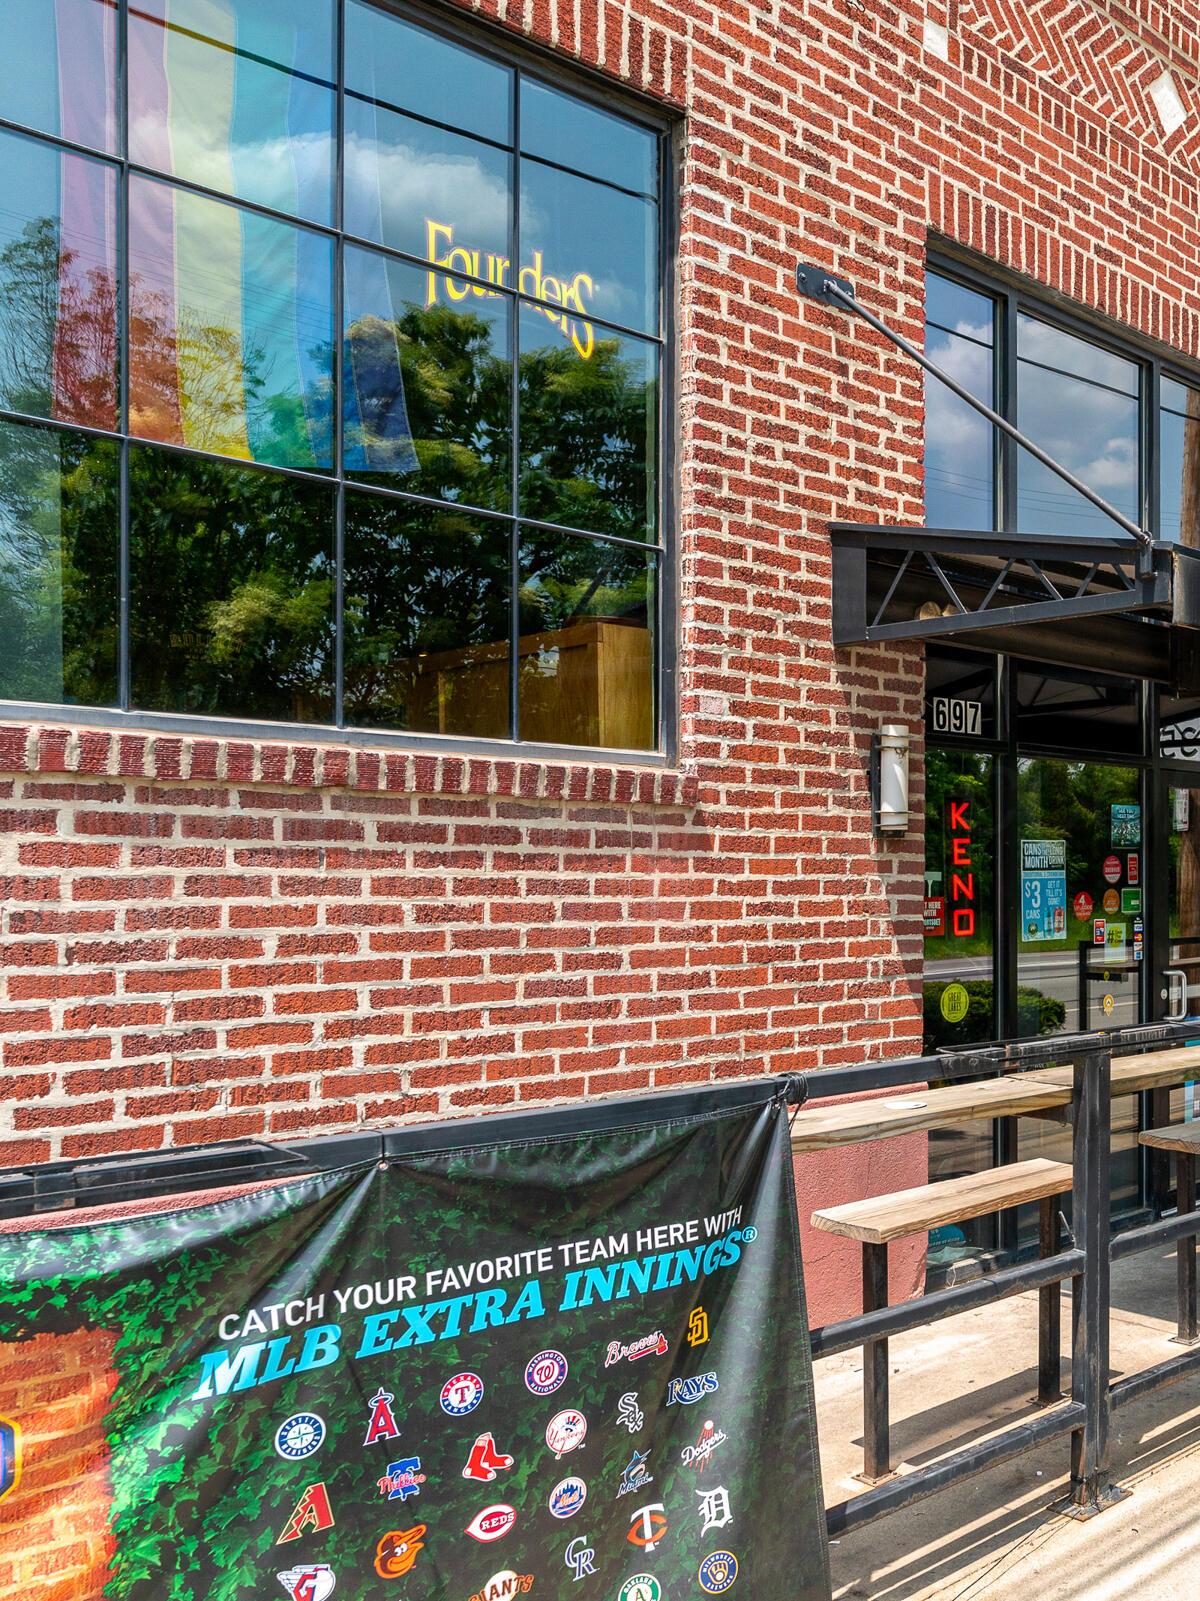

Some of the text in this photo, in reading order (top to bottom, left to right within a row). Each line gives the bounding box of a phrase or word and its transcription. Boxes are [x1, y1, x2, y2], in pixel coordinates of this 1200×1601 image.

[935, 698, 980, 733] 697
[1024, 843, 1042, 856] CANS
[950, 801, 975, 938] KENO
[1024, 856, 1049, 869] MONTH
[1025, 880, 1041, 909] $3
[1026, 909, 1041, 920] CANS
[947, 991, 962, 1001] GREAT
[947, 1002, 962, 1012] LAKES
[218, 1205, 743, 1341] CATCH YOUR FAVORITE TEAM HERE WITH
[190, 1323, 343, 1401] MLB
[354, 1279, 546, 1360] EXTRA
[604, 1330, 662, 1368] Braves
[527, 1352, 564, 1374] WASHINGTON
[445, 1375, 479, 1391] TEXAS
[530, 1375, 564, 1393] NATIONALS
[665, 1372, 720, 1407] RAYS
[455, 1385, 471, 1405] T
[681, 1429, 727, 1466] Dodgers
[481, 1511, 515, 1531] REDS
[702, 1554, 734, 1573] MILWAUKEE
[623, 1576, 653, 1593] OAKLAND
